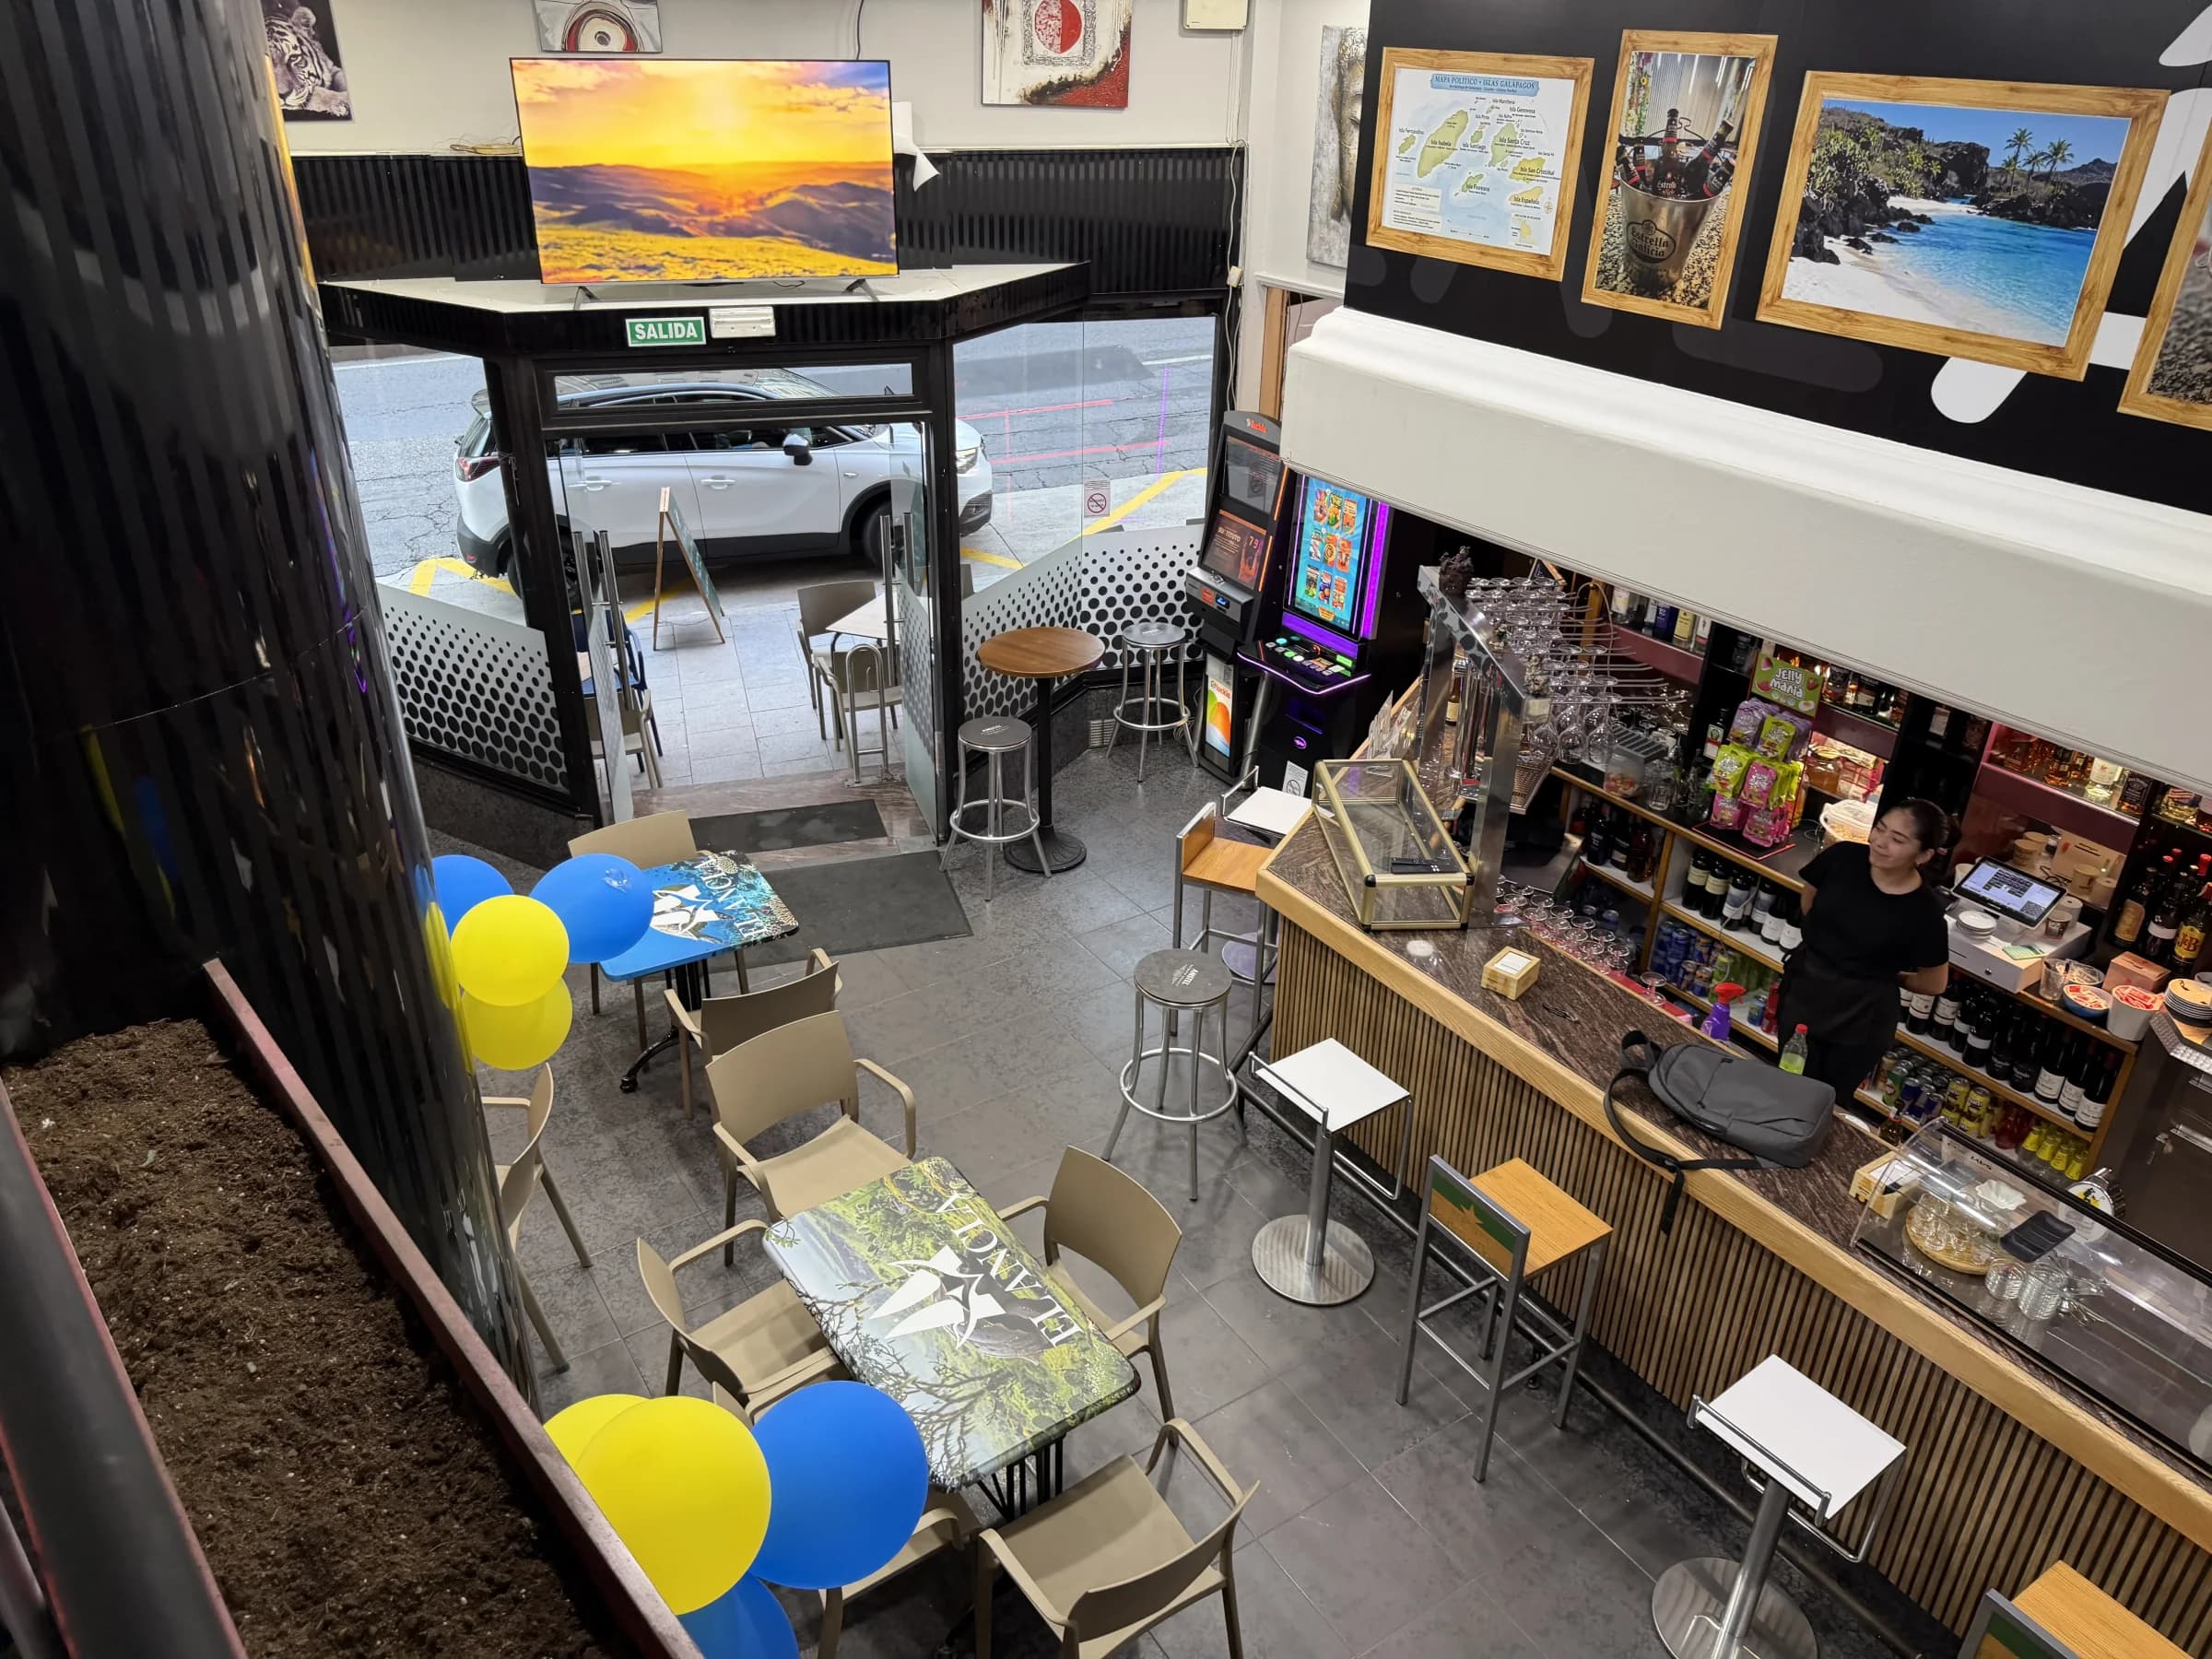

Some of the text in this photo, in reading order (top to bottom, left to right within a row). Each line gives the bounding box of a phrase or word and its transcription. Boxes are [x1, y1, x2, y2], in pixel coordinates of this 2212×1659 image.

[1483, 78, 1498, 87] ISLAS
[634, 323, 699, 340] SALIDA
[694, 857, 769, 938] EL ANCLA
[935, 1193, 1084, 1347] EL ANCLA
